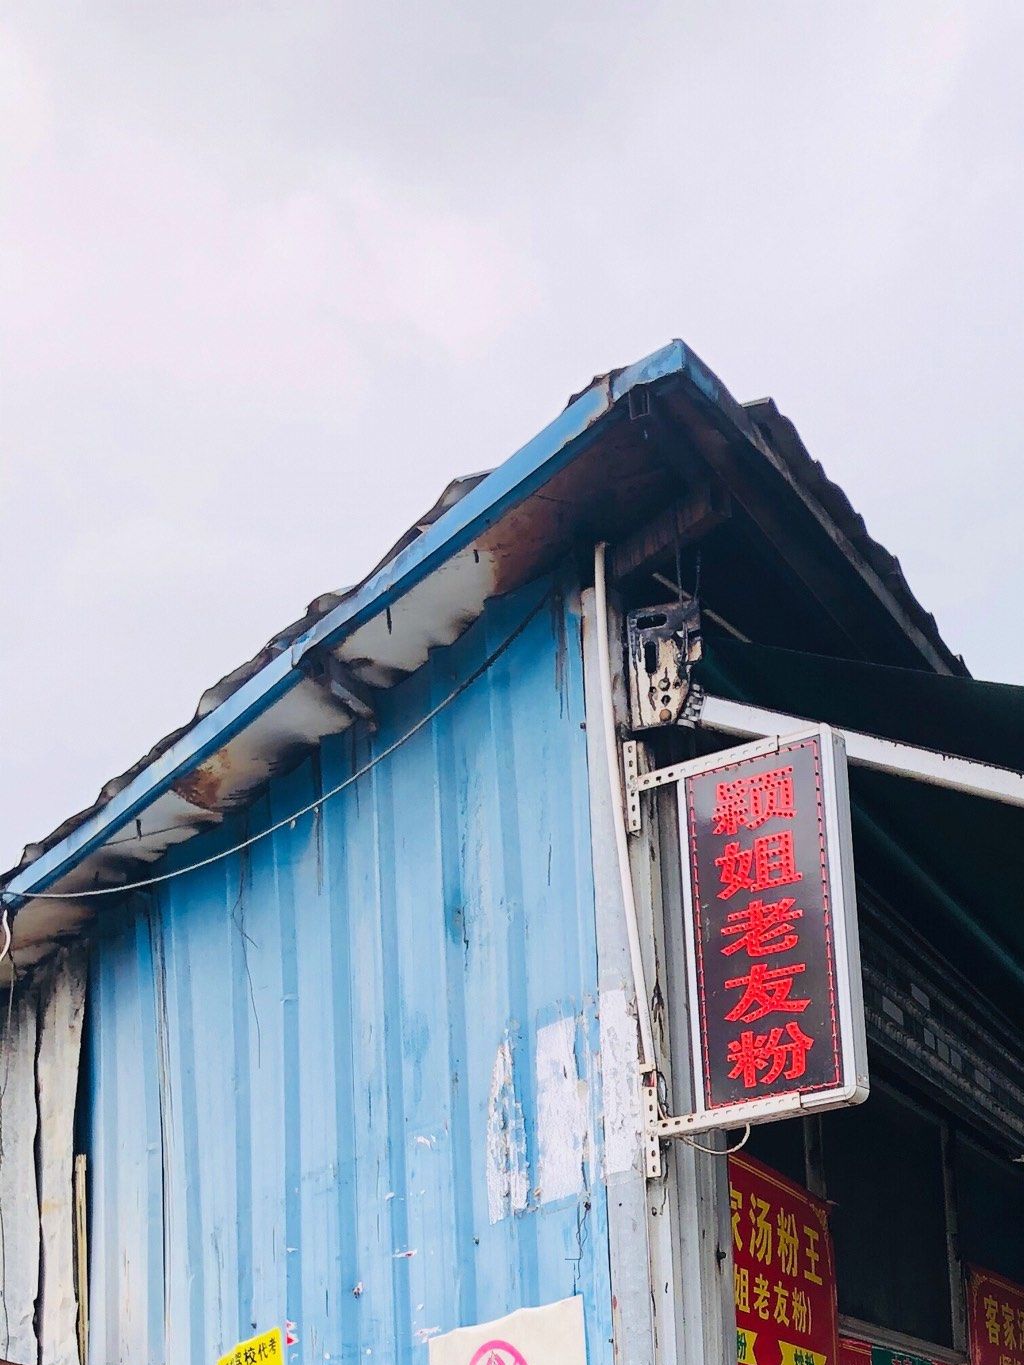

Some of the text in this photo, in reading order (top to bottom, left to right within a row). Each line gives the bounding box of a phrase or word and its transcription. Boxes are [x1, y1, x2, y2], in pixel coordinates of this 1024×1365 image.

[712, 766, 815, 1088] 颖姐老友粉
